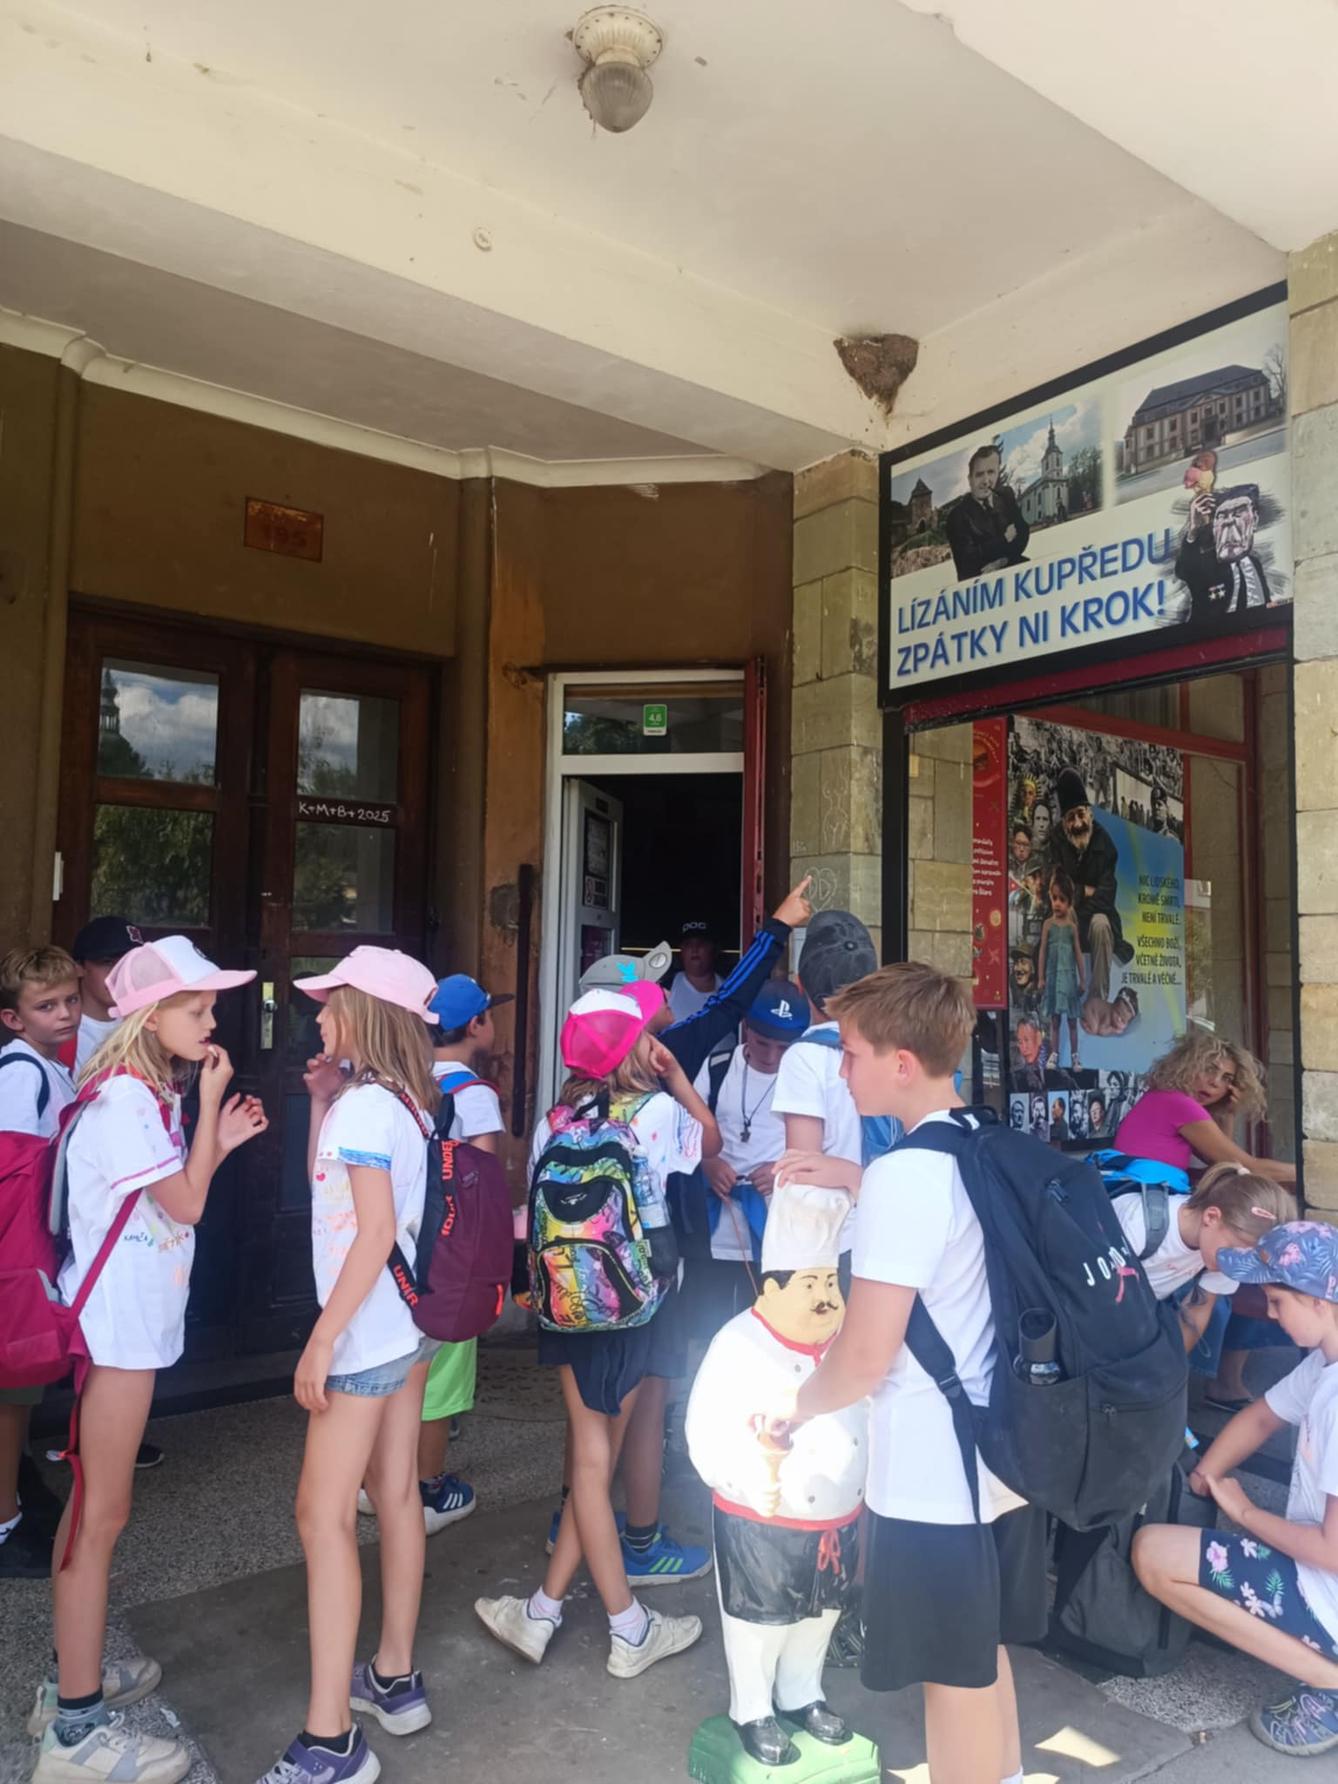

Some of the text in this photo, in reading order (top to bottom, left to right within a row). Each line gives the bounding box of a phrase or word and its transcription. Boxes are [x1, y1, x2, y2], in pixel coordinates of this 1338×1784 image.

[897, 527, 1171, 634] LÍZÁNÍM KUPŘEDU
[896, 579, 1166, 676] ZPÁTKY NI KROK!
[1136, 934, 1165, 949] VŠECHNO
[1142, 911, 1157, 923] NENÍ
